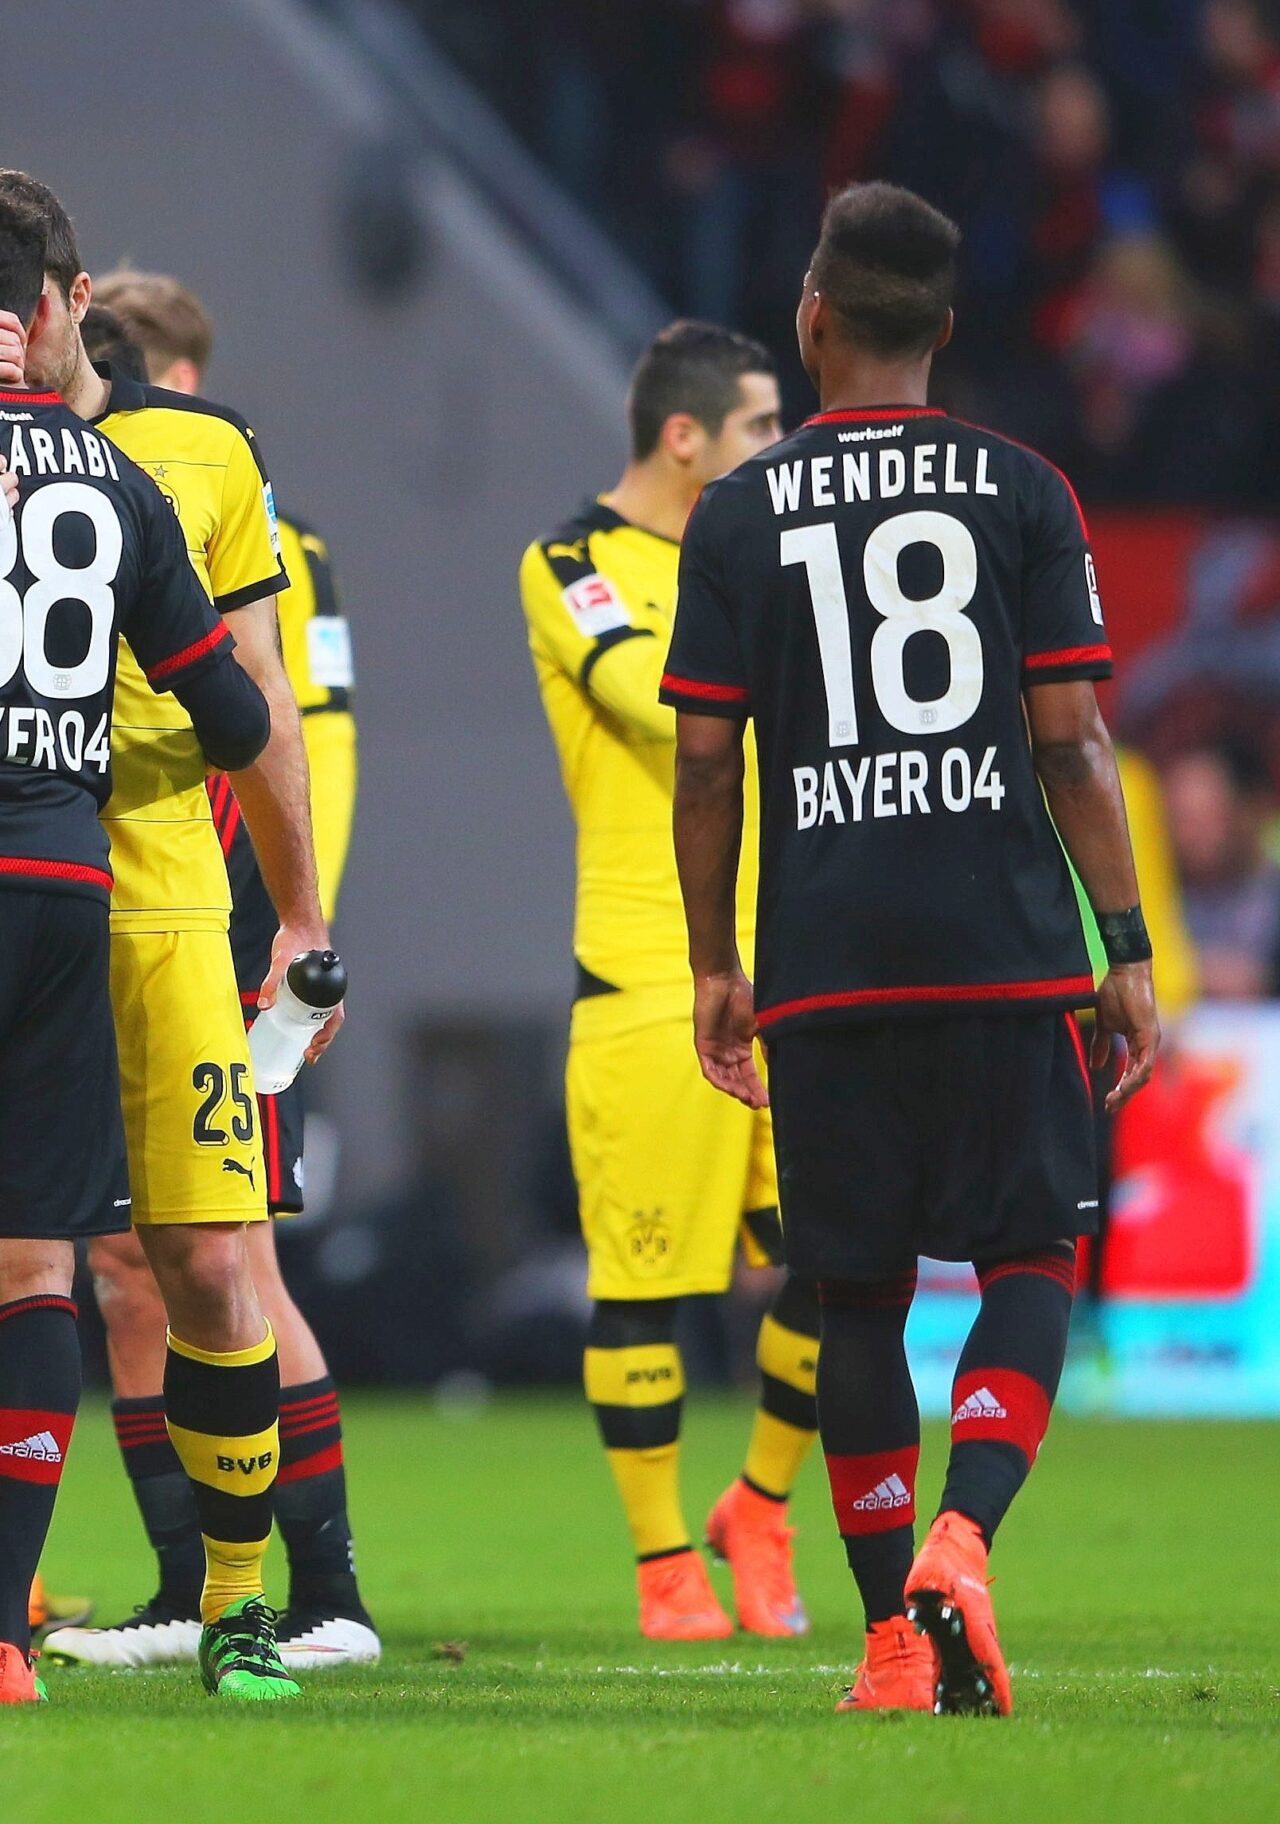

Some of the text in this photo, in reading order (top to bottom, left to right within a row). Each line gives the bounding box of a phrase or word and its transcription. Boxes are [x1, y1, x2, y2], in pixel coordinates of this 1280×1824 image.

[837, 425, 905, 443] werkself
[765, 443, 999, 516] WENDELL
[779, 510, 985, 748] 18
[792, 745, 1006, 831] BAYER 04
[192, 1062, 254, 1147] 25
[951, 1405, 1008, 1425] adidas
[0, 1444, 63, 1463] adidas
[216, 1451, 273, 1475] BVB
[852, 1492, 912, 1511] adidas
